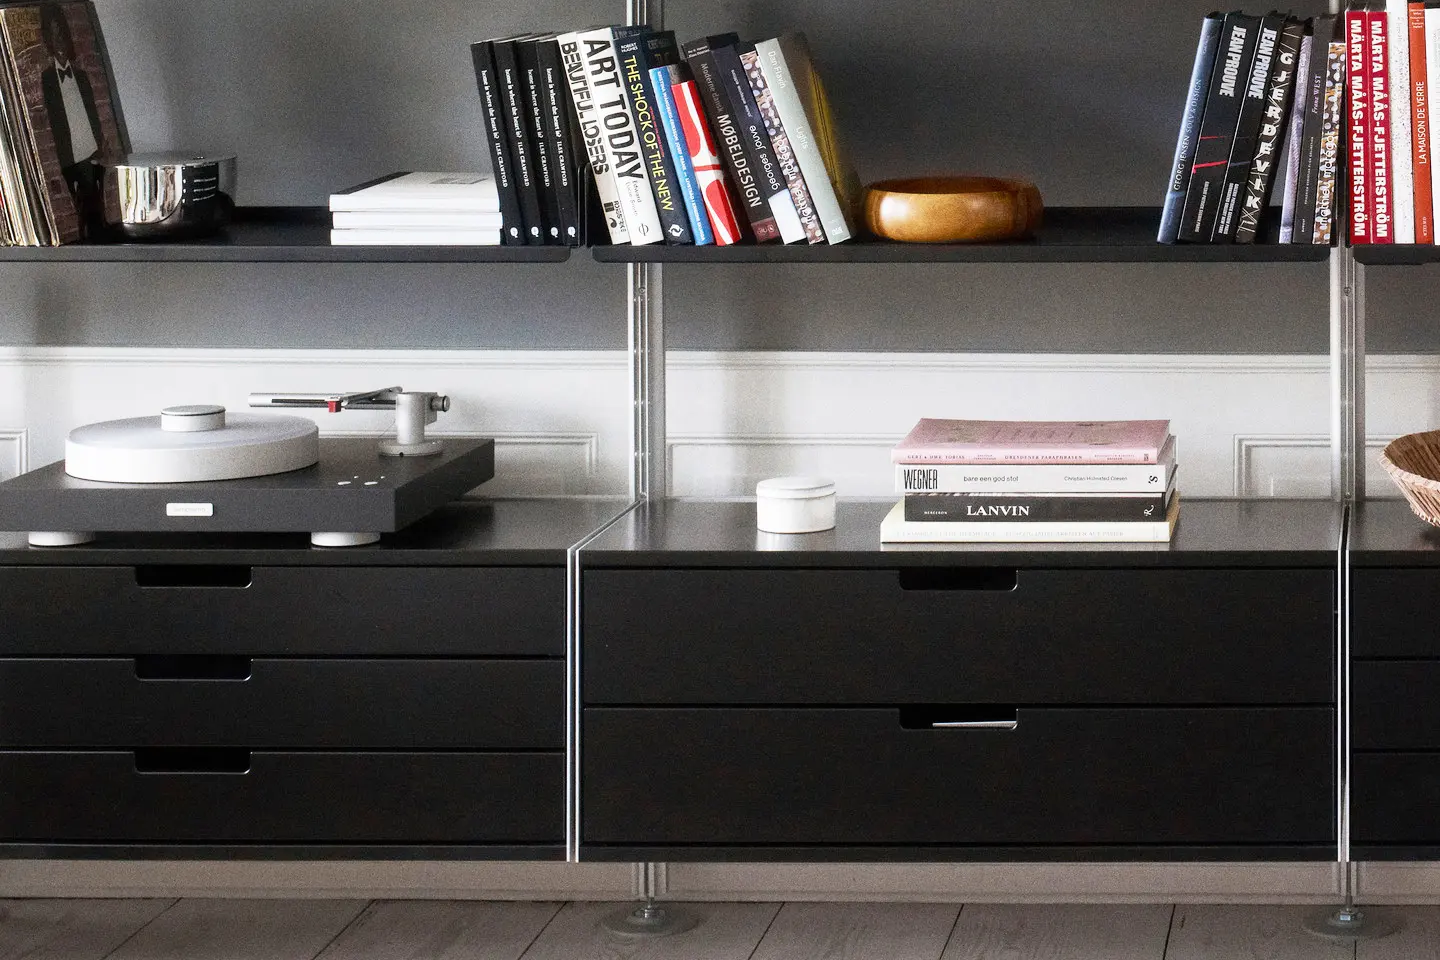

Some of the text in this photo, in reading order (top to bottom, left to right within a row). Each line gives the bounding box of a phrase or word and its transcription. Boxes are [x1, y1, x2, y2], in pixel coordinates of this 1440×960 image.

[561, 41, 609, 175] BEAUTIFUL LOSERS
[583, 40, 644, 179] ART TODAY
[623, 55, 673, 212] THE SHOCK OF THE NEW
[717, 114, 762, 208] MØBELDESIGN
[749, 125, 780, 191] georges jouve
[1350, 20, 1368, 236] MÄRTA MÅÅS-FJETTERSTRÖM
[1371, 21, 1390, 238] MÄRTA MÅÅS-FJETTERSTRÖM
[903, 469, 938, 490] WEGNER
[966, 505, 1030, 516] LANVIN
